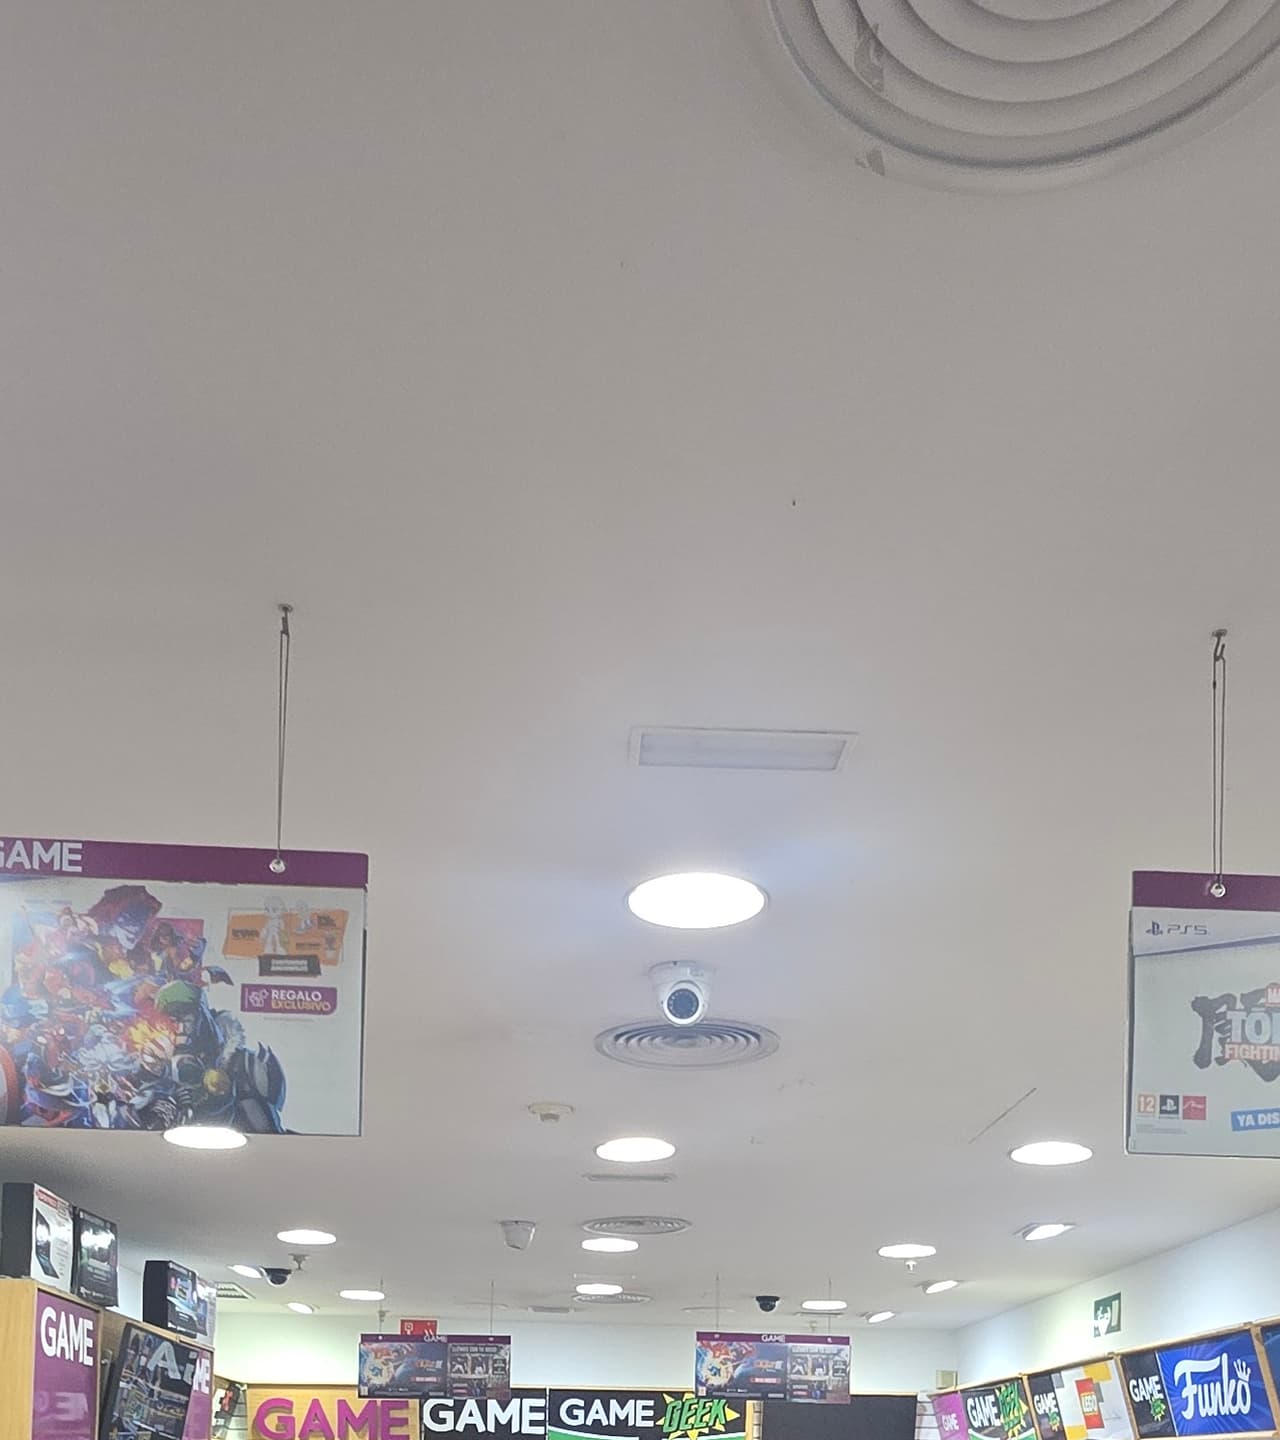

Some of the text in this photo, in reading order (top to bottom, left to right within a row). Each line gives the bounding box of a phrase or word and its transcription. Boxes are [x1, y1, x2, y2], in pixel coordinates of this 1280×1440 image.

[1167, 924, 1207, 936] PS5
[271, 988, 322, 1001] REGALO
[271, 1000, 331, 1012] EXCLUSIVO
[1139, 1095, 1155, 1113] 12
[1236, 1112, 1255, 1127] YA
[40, 1307, 94, 1366] GAME
[423, 1335, 448, 1343] GAME
[1129, 1375, 1163, 1402] GAME
[1174, 1353, 1251, 1419] Funko
[966, 1396, 1001, 1428] GAME
[1033, 1393, 1057, 1414] GAME
[1081, 1394, 1098, 1414] LEGO
[423, 1398, 545, 1435] GAME
[560, 1398, 730, 1433] GAME GEEK
